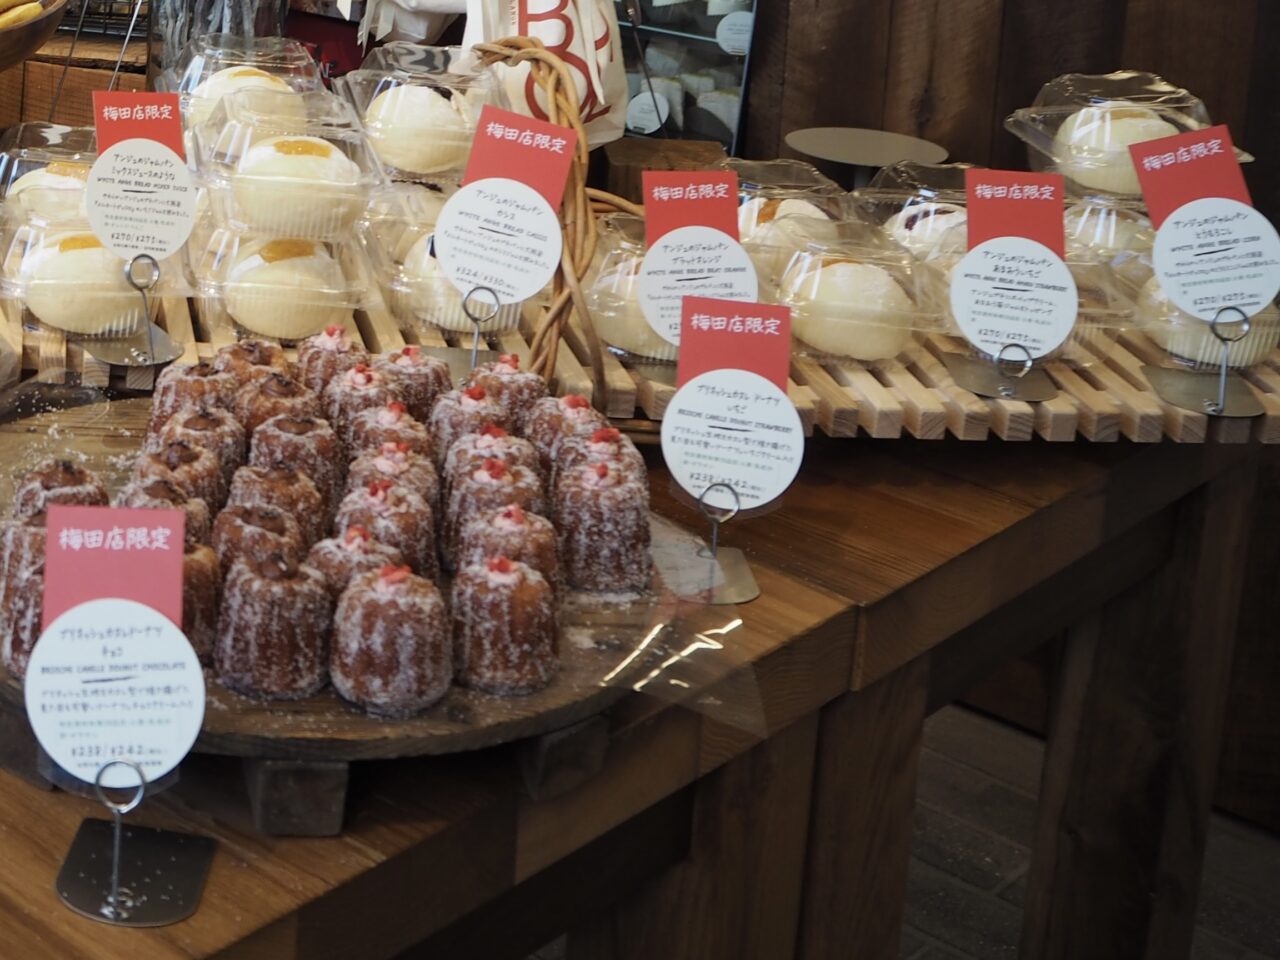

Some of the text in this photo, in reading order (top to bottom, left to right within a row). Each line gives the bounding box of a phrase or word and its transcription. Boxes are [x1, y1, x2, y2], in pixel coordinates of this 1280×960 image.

[102, 104, 173, 120] 梅田店限定
[485, 121, 567, 154] 梅田店限定
[113, 153, 175, 168] アンジュのジャムパン
[1142, 139, 1225, 172] 梅田店限定
[475, 189, 545, 216] アンジュのジャムパン
[652, 183, 729, 201] 梅田店限定
[975, 183, 1055, 201] 梅田店限定
[690, 313, 781, 335] 梅田店限定
[59, 527, 171, 550] 梅田店限定
